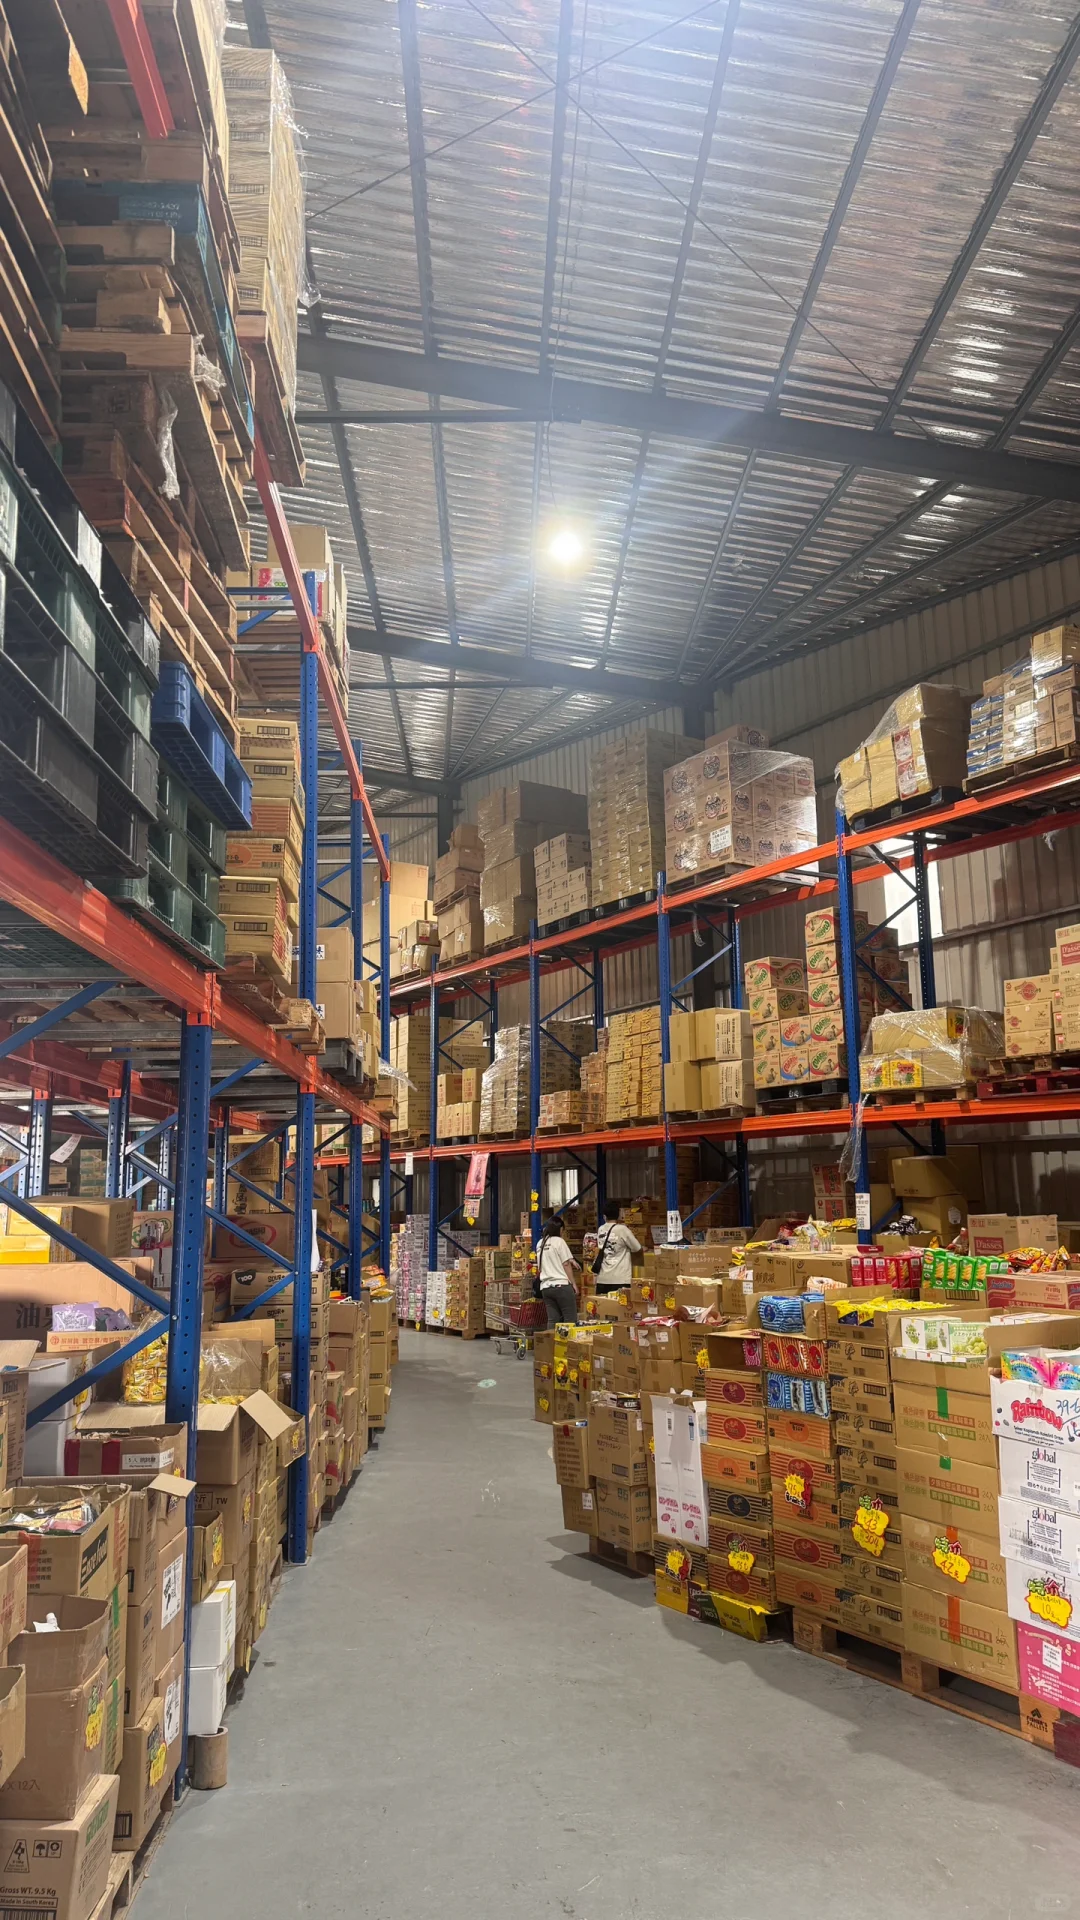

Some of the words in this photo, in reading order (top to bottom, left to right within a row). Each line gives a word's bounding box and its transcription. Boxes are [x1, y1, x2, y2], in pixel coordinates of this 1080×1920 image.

[1011, 1397, 1063, 1431] Rainbow
[1031, 1448, 1056, 1464] global
[215, 1497, 228, 1505] TW
[1031, 1507, 1057, 1524] global
[1026, 1721, 1048, 1733] PALLETS
[0, 1886, 20, 1895] Gross
[21, 1887, 33, 1895] WT.
[46, 1888, 56, 1896] Kg
